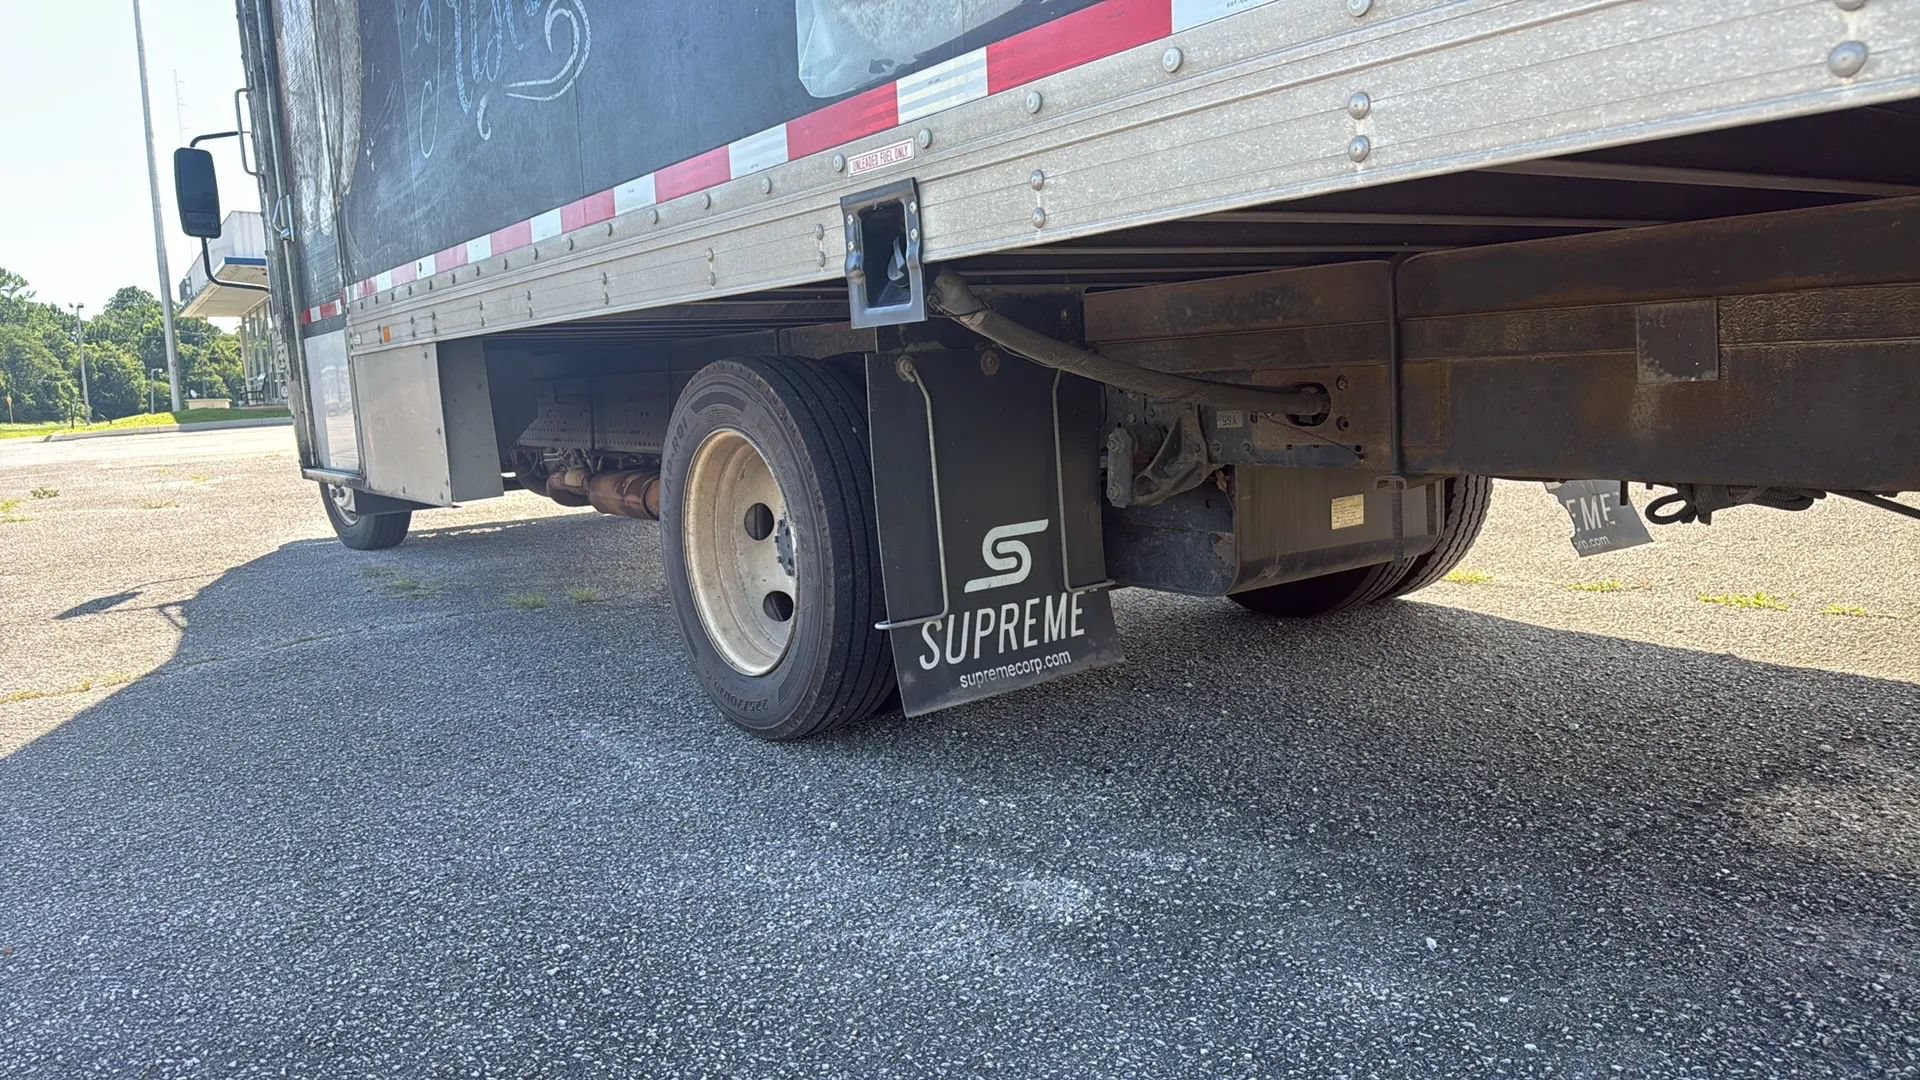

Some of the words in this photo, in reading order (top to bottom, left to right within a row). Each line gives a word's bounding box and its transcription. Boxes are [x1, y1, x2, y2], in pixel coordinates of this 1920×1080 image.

[852, 152, 879, 172] UNLEADED
[879, 149, 893, 164] FUEL
[894, 145, 908, 160] ONLY
[918, 590, 1085, 671] SUPREME
[959, 650, 1072, 689] supremecorp.com
